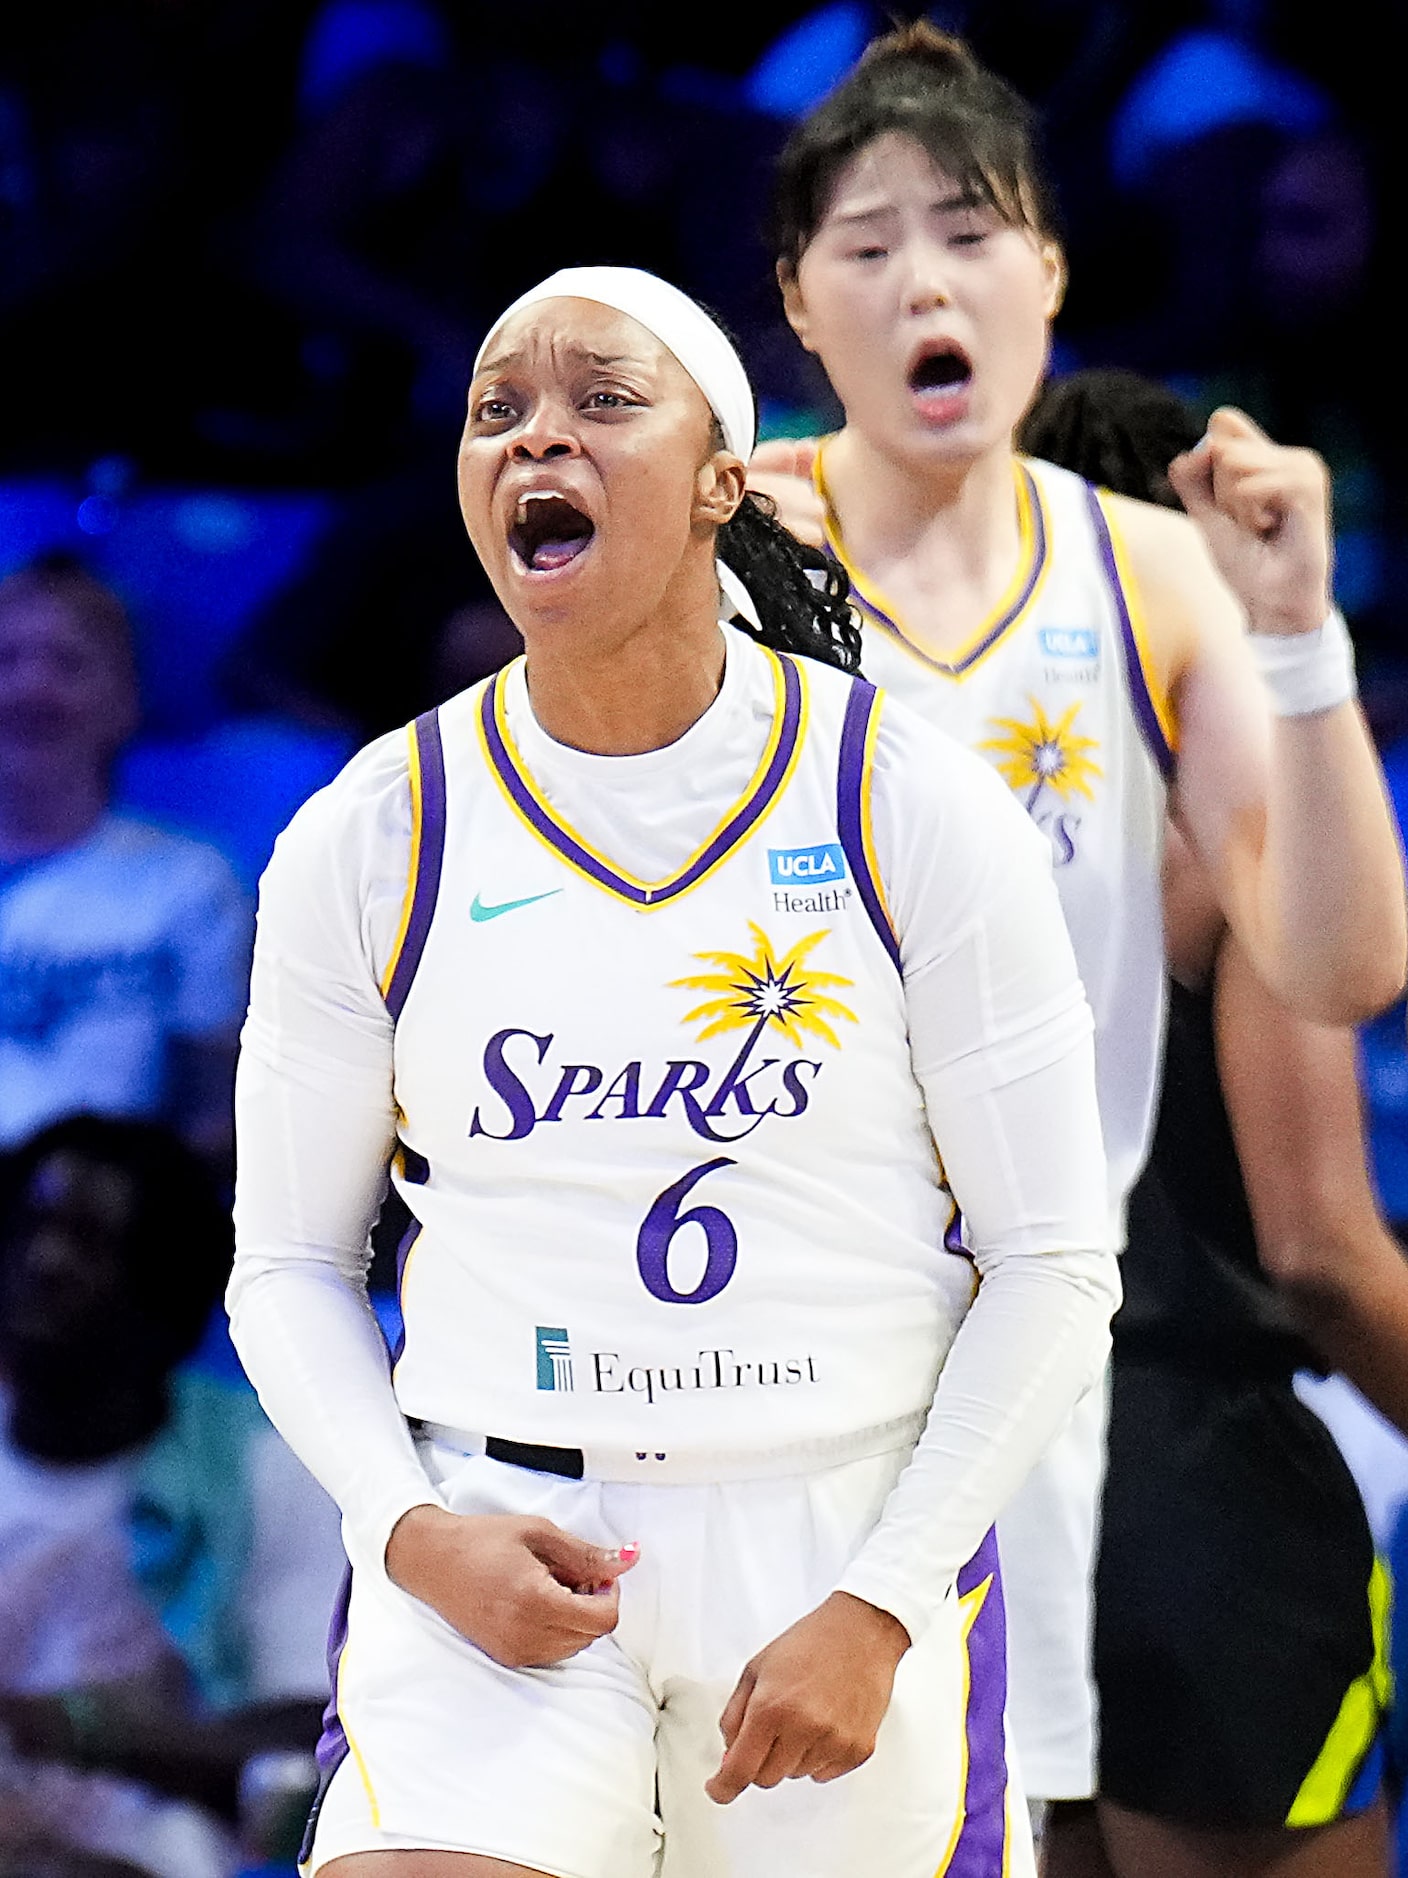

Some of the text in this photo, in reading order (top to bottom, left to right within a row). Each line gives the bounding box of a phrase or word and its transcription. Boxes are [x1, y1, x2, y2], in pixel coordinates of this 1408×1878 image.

[777, 851, 837, 877] UCLA
[636, 1156, 738, 1304] 6
[588, 1350, 821, 1404] EquiTrust
